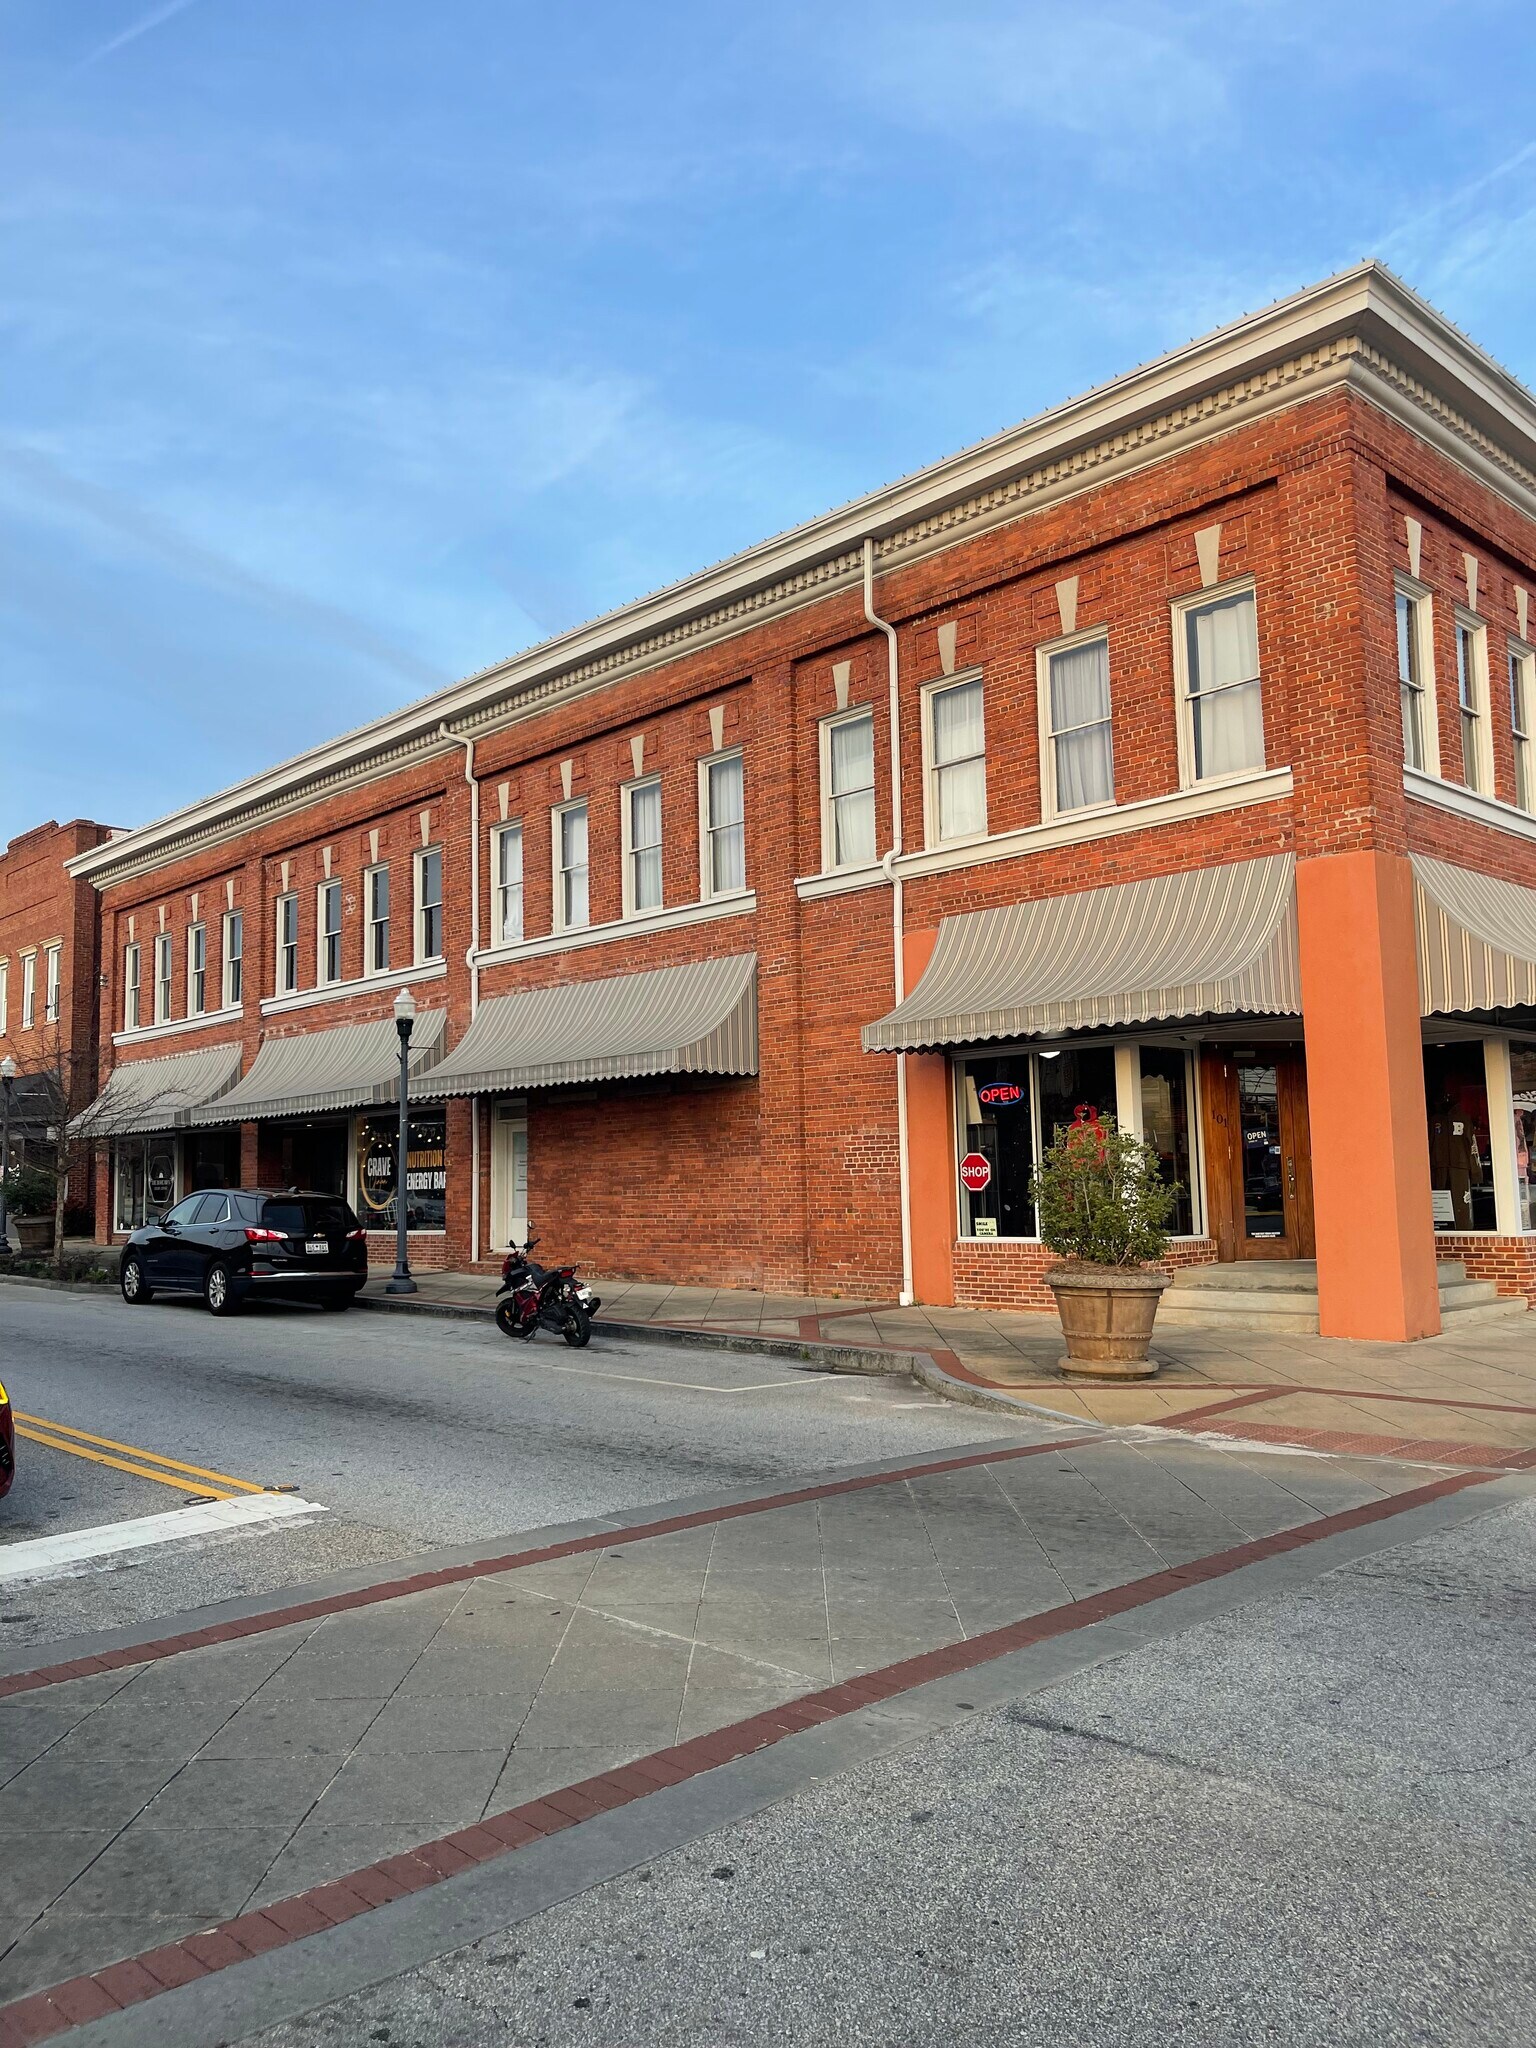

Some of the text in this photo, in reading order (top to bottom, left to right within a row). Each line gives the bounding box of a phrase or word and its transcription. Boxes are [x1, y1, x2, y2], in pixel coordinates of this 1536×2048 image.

[980, 1086, 1020, 1102] OPEN
[1212, 1110, 1227, 1128] 101
[1247, 1130, 1267, 1140] OPEN
[1452, 1121, 1464, 1136] B
[367, 1156, 391, 1177] CRAVE
[407, 1150, 442, 1168] NUTRITION
[961, 1166, 989, 1177] SHOP
[406, 1172, 432, 1190] ENERGY
